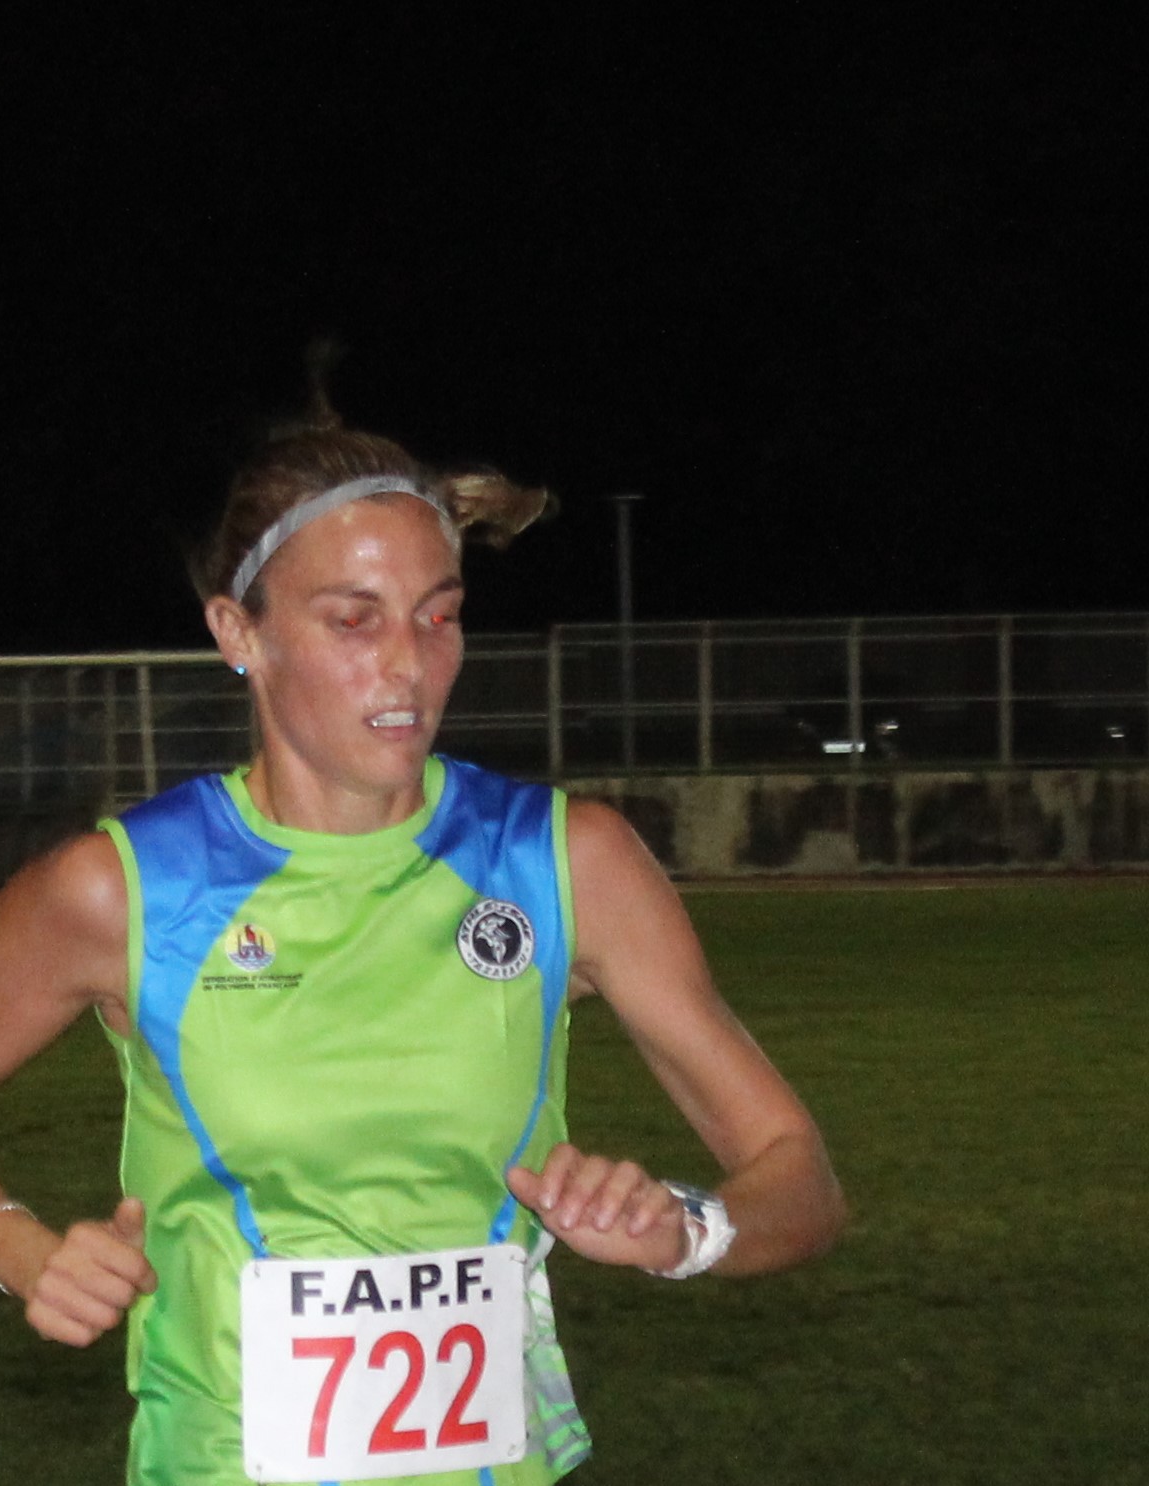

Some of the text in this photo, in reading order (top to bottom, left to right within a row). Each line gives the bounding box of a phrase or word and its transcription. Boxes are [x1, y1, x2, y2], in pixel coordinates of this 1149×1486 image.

[459, 899, 534, 943] ATHLEISME
[291, 1257, 494, 1317] F.A.P.F.
[291, 1322, 490, 1458] 722
